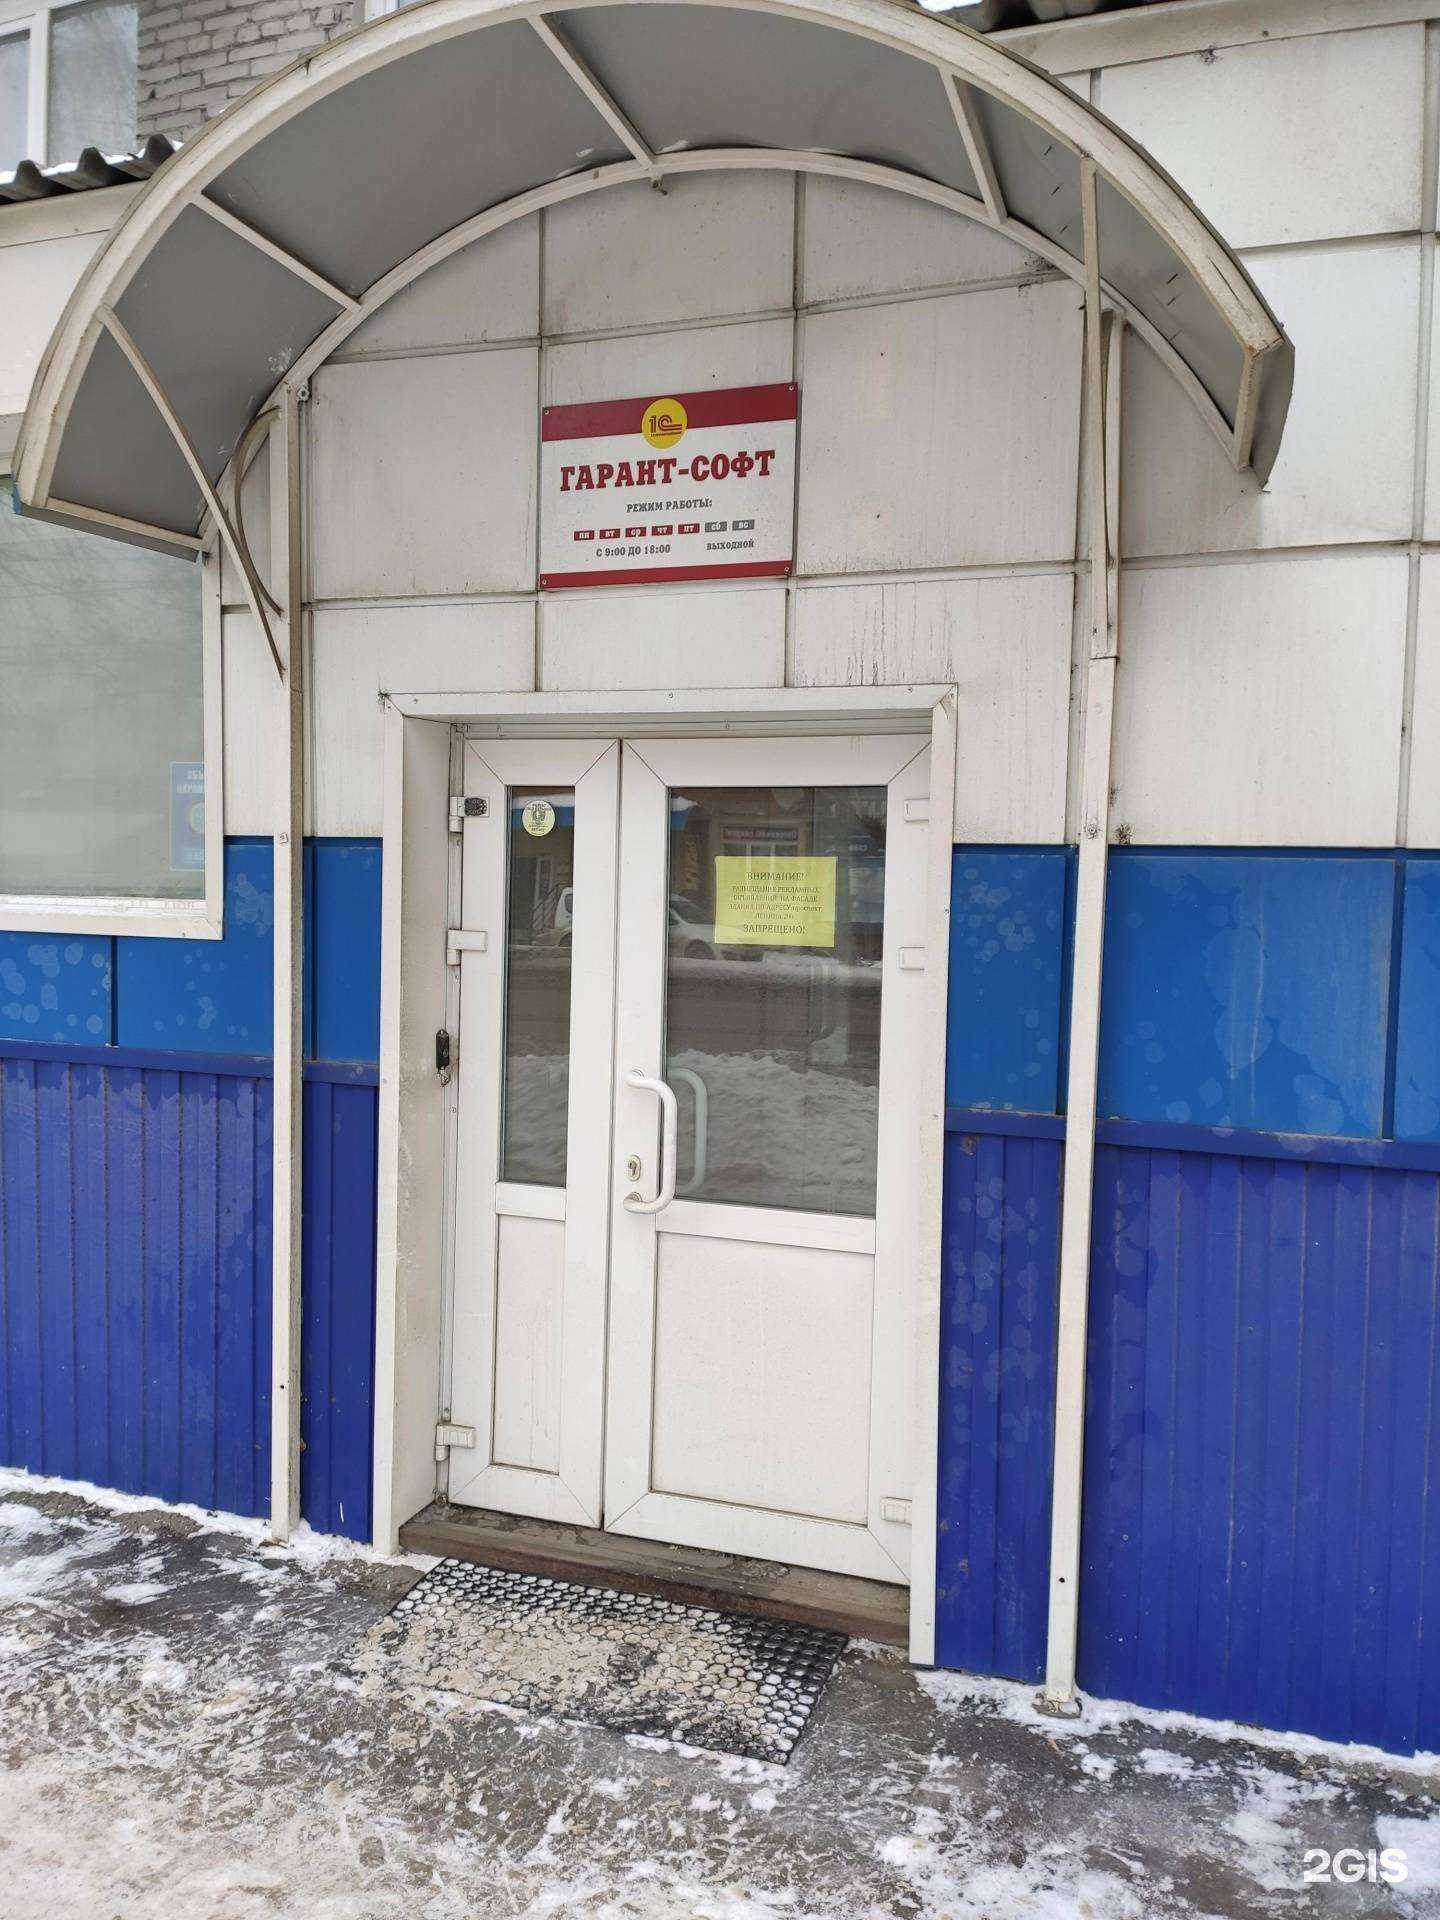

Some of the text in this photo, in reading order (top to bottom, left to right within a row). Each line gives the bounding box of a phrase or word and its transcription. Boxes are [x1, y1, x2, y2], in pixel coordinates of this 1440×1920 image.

[559, 449, 776, 492] ГАРАНТ-СОФТ
[626, 497, 713, 513] РЕЖИМ РАБОТЫ:
[604, 546, 626, 557] 9:00
[627, 545, 642, 557] ДО
[644, 544, 671, 555] 18:00
[747, 871, 805, 881] ВНИМАНИЕ!
[743, 924, 806, 935] ЗАПРЕЩЕНО!
